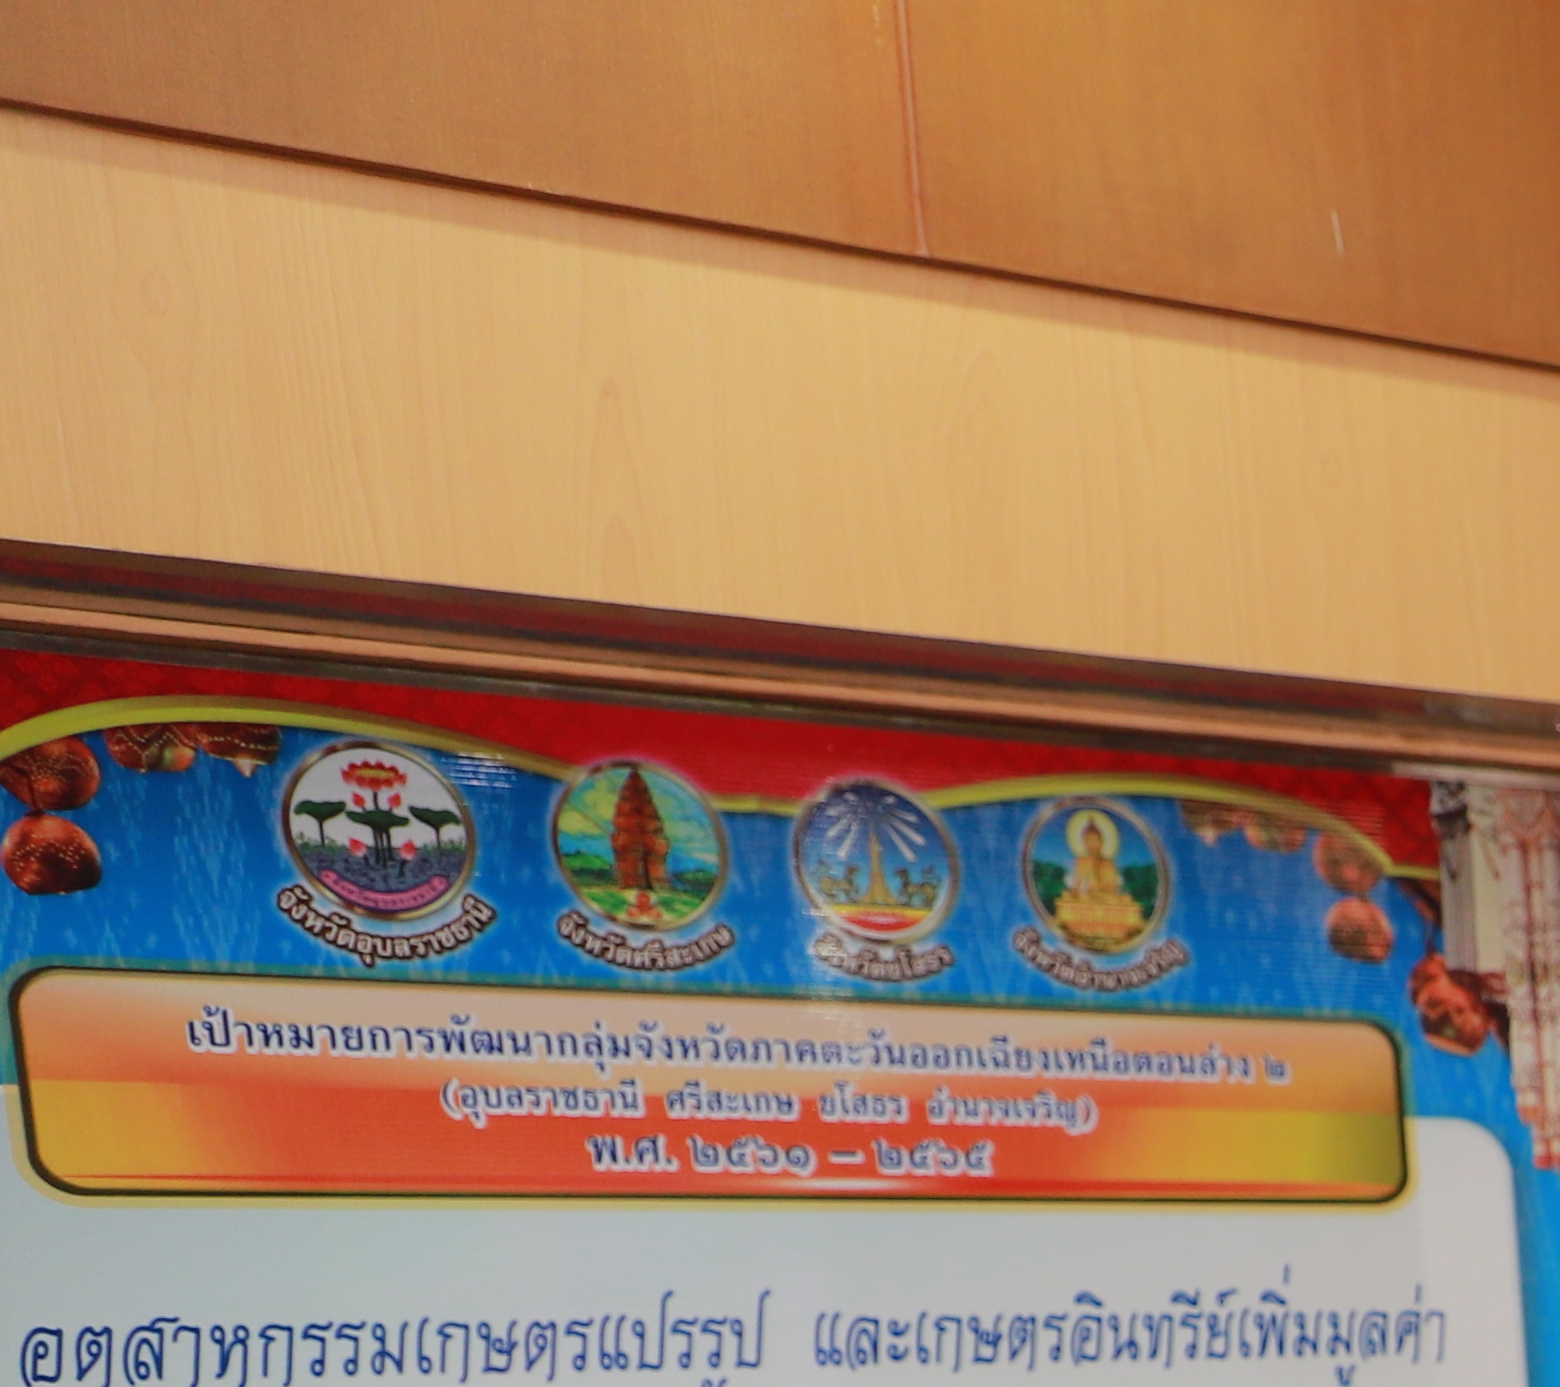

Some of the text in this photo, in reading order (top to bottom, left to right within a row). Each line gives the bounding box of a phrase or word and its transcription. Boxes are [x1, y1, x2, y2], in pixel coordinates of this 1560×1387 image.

[277, 885, 497, 966] จังหวัดอุบลราชธานี
[557, 909, 735, 970] จังหวัดศรีสะเกษ
[187, 1005, 1251, 1081] เป้าหมายการพัฒนากลุ่มจังหวัดภาคตะวันออกเฉียงเหนือตอนล่าง
[441, 1079, 640, 1127] (อุบลราชธานี
[666, 1080, 796, 1119] ศรีสะเกษ
[819, 1081, 905, 1121] ยโสธร
[587, 1133, 679, 1171] พ.ศ.
[690, 1132, 815, 1176] ๒๕๖๑
[875, 1137, 994, 1176] ๒๕๖๕
[813, 1264, 1447, 1387] และเกษตรอินทรีย์เพิ่มมูลค่า
